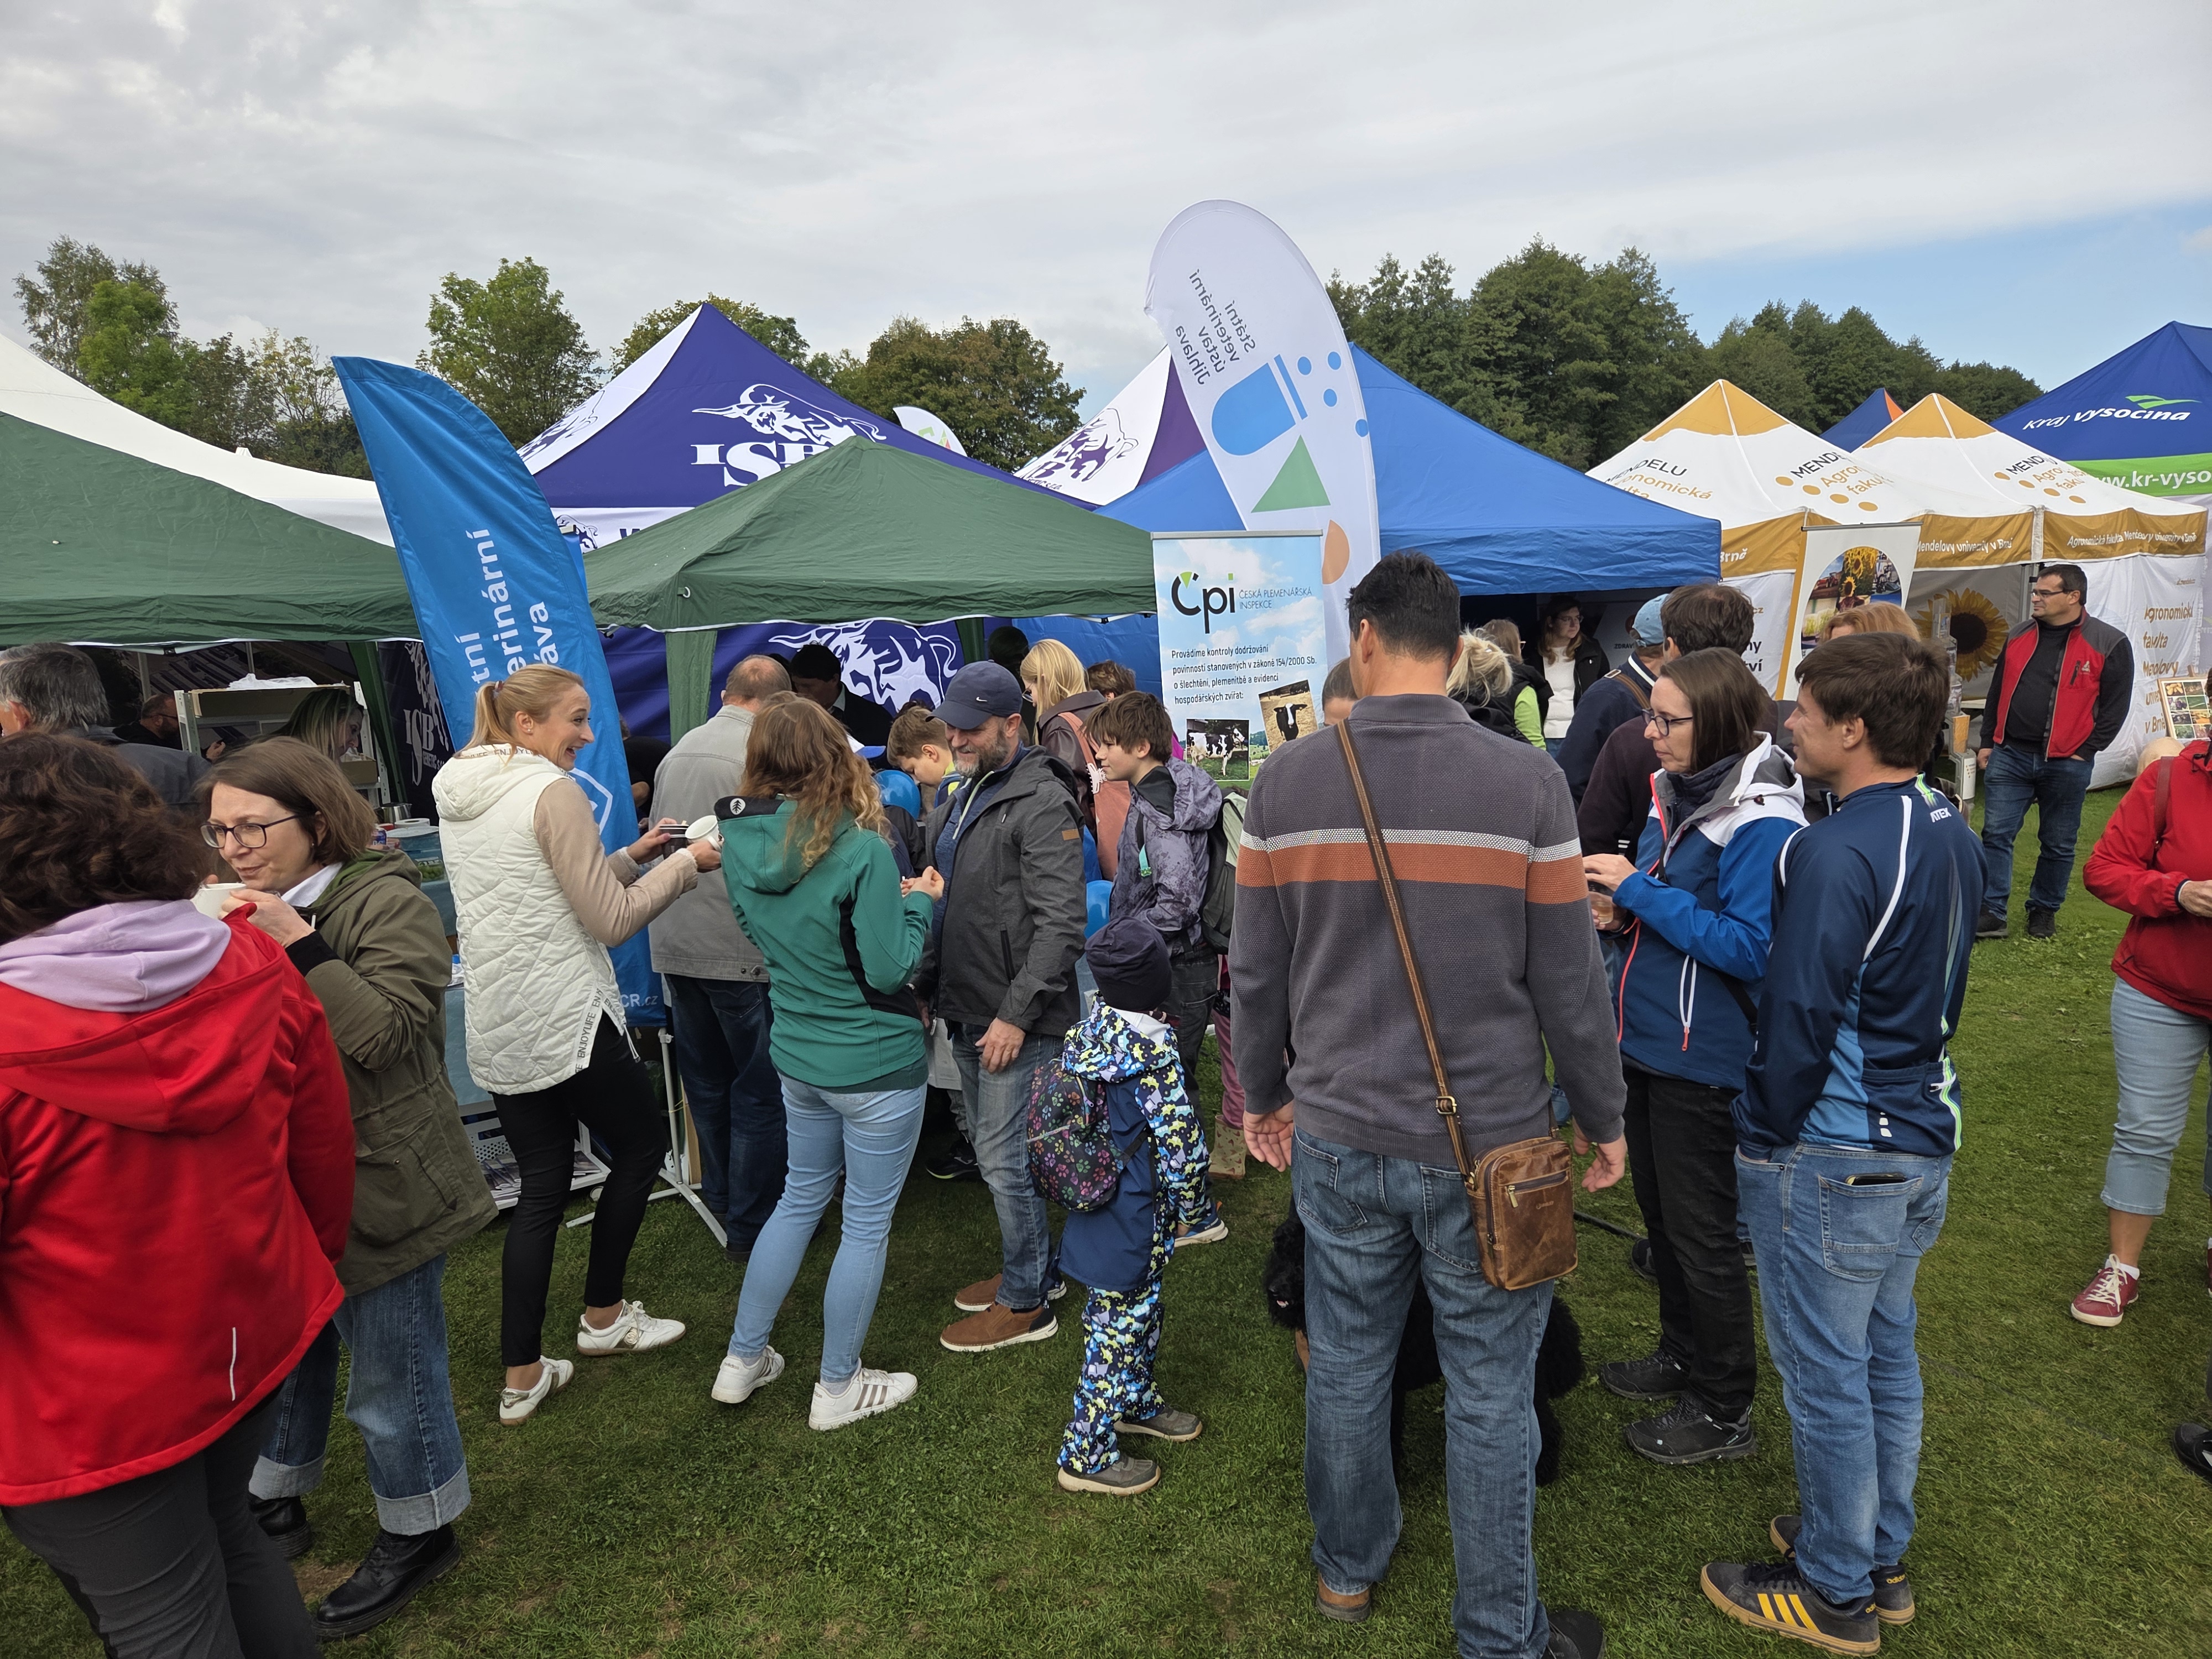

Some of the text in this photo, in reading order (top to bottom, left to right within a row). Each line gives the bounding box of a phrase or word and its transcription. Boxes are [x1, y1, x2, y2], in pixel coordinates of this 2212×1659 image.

[1791, 452, 1846, 478] MEND
[1239, 588, 1262, 599] ČESKÁ
[466, 529, 526, 675] erinární
[1239, 600, 1272, 609] INSPEKCE
[529, 602, 559, 664] áva
[1207, 646, 1233, 657] kontroly
[1235, 644, 1269, 655] dodržování
[454, 633, 490, 684] tní
[1207, 660, 1246, 671] stanovených
[1276, 656, 1305, 667] 154/2000
[1307, 656, 1317, 664] Sb.
[1212, 676, 1246, 688] plemenitbě
[1254, 673, 1279, 683] evidenci
[1175, 693, 1223, 705] hospodářských
[2145, 721, 2150, 734] v
[620, 993, 658, 1008] CR.cz
[577, 1012, 597, 1058] ENJOYLIFE
